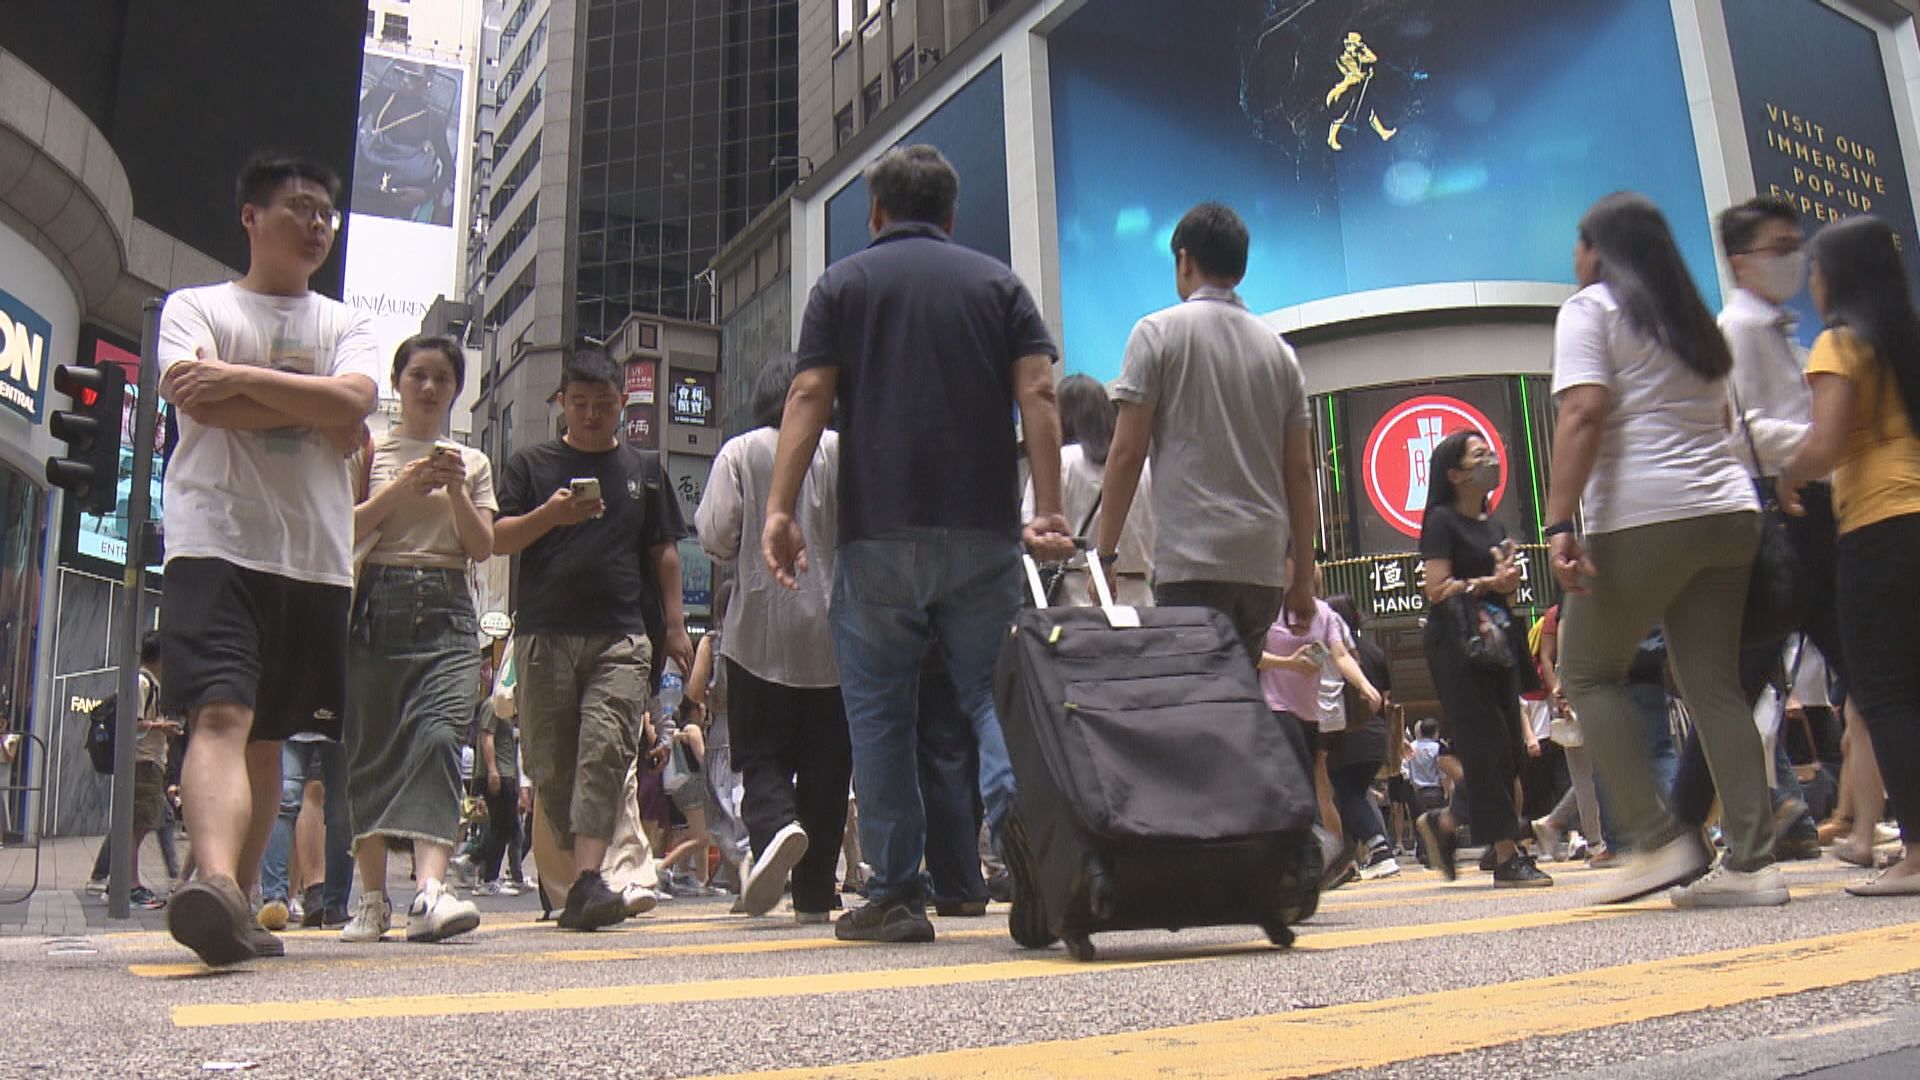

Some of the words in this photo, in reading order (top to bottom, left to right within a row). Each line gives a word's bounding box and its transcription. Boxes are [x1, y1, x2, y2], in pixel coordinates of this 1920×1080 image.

[1766, 103, 1823, 143] VISIT
[1836, 136, 1876, 167] OUR
[1767, 129, 1885, 195] IMMERSIVE
[1793, 166, 1872, 212] POP-UP
[1373, 594, 1423, 614] HANG
